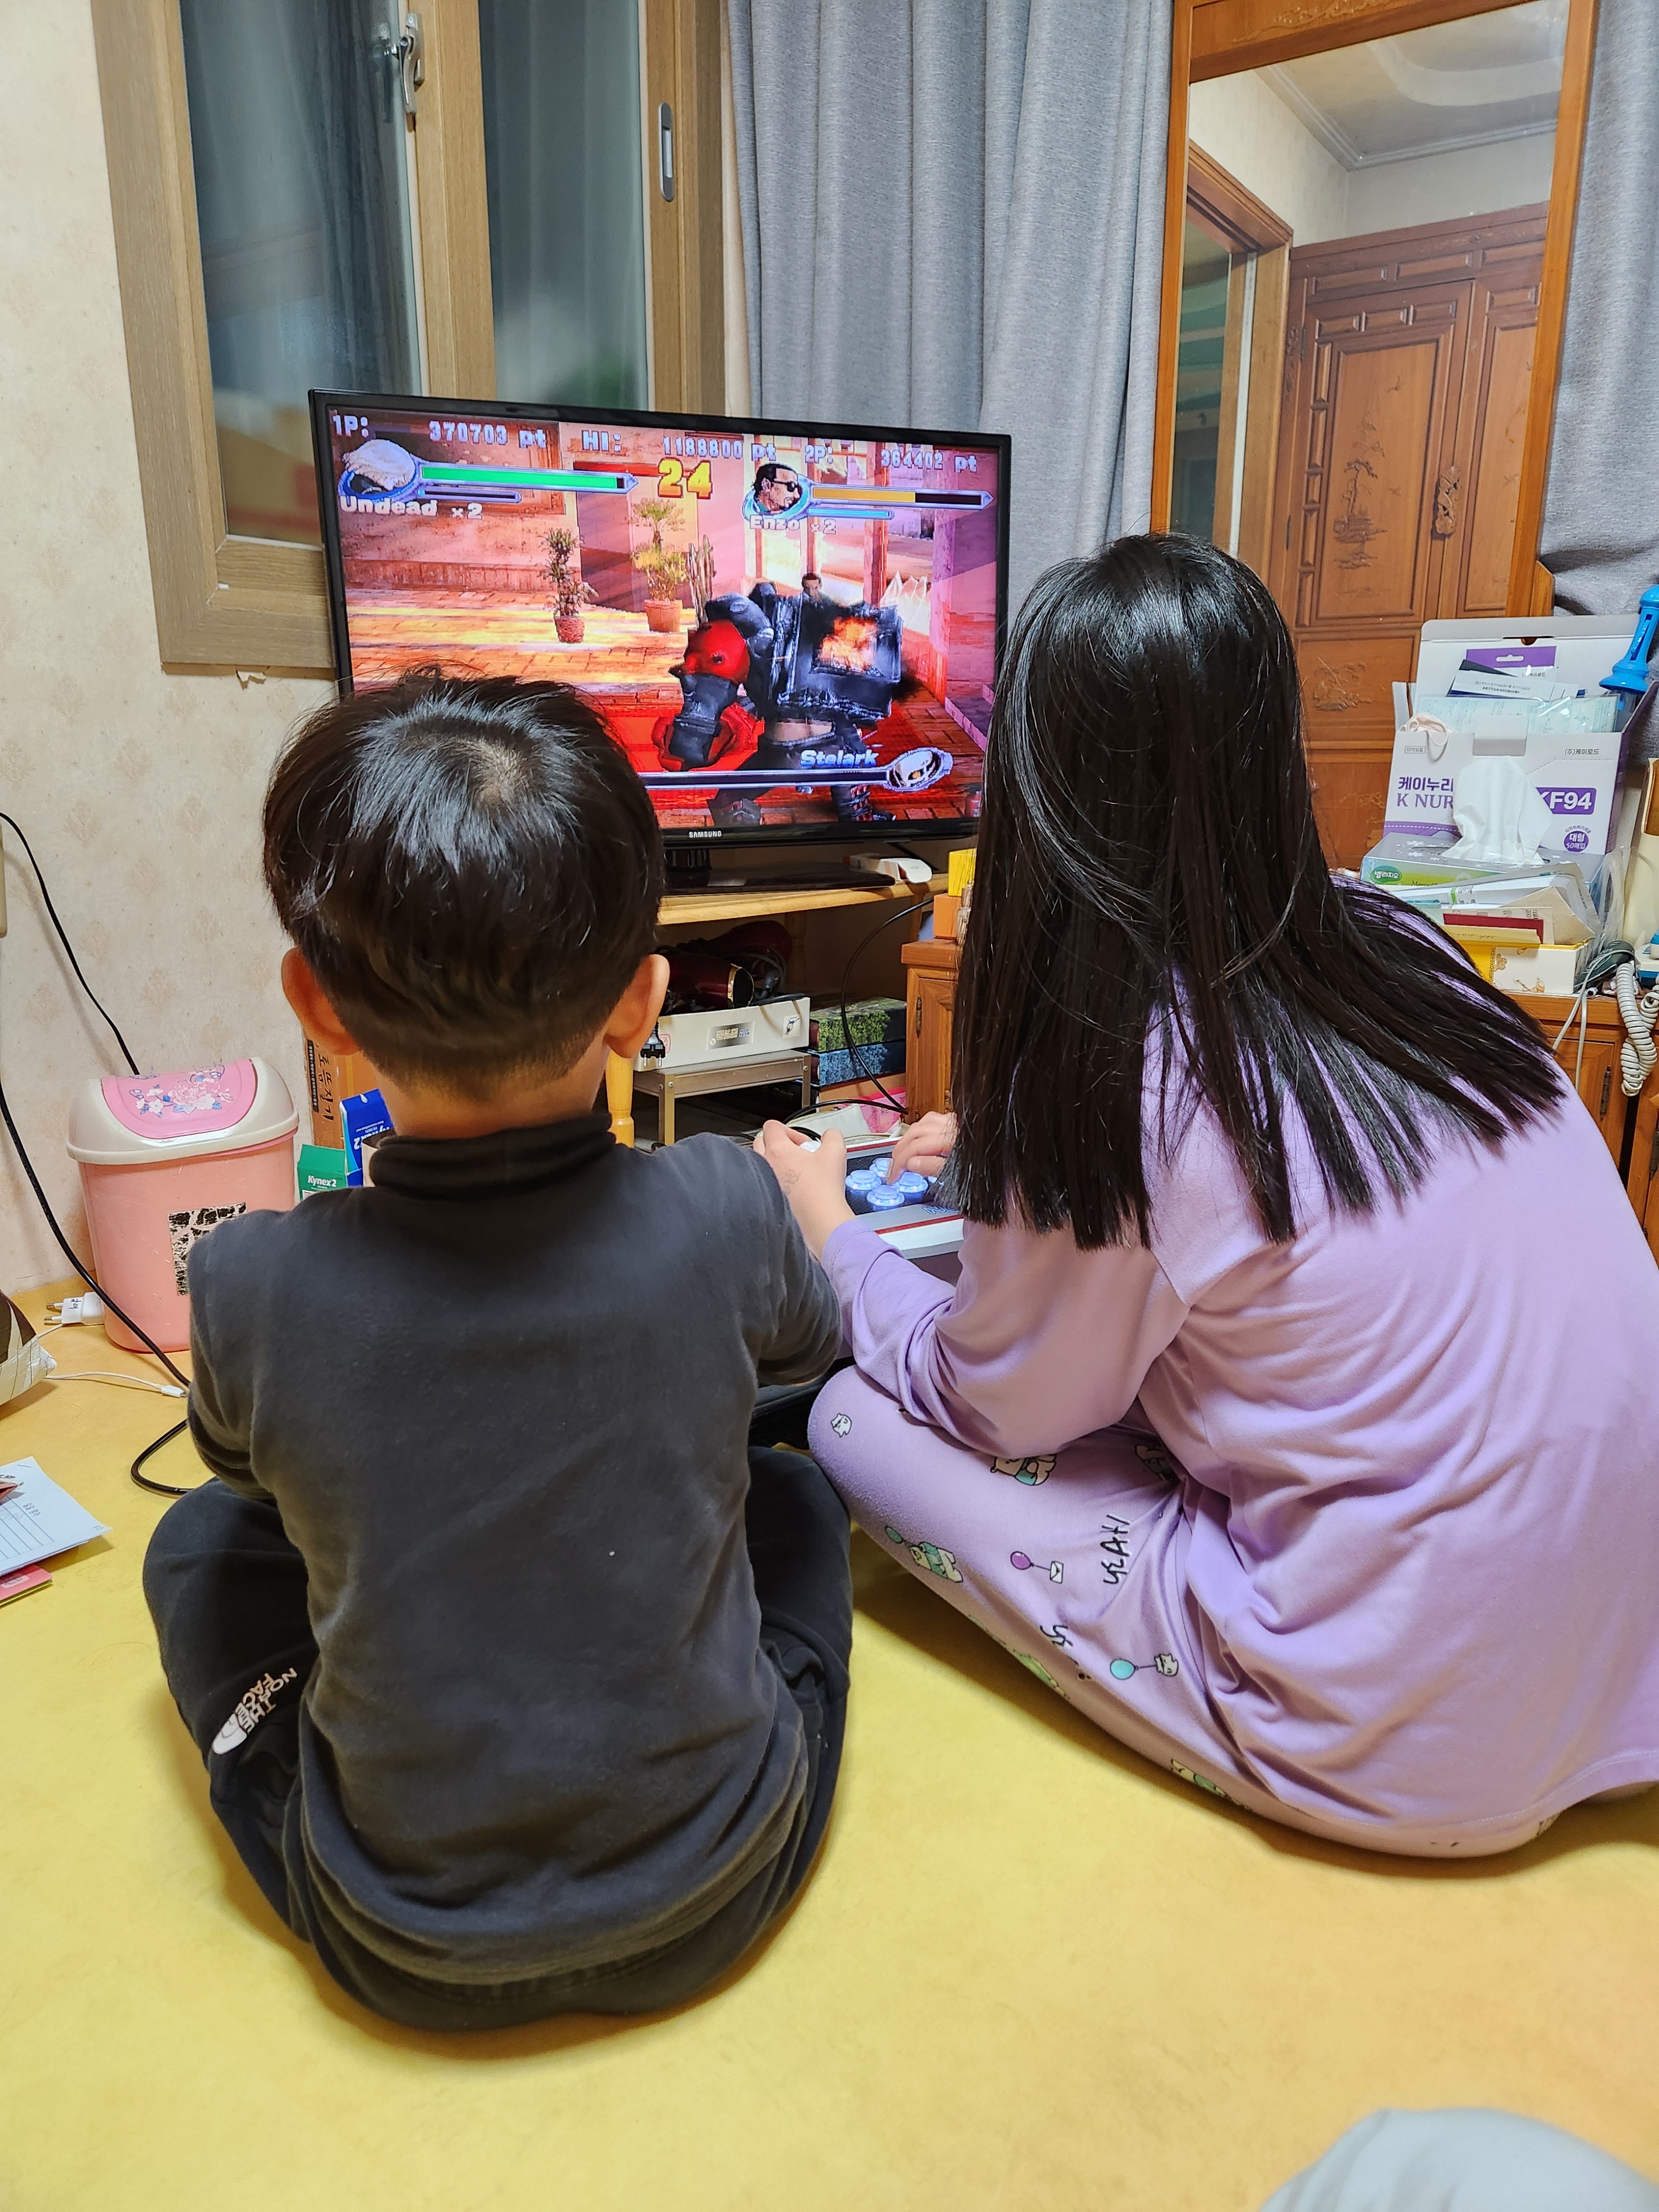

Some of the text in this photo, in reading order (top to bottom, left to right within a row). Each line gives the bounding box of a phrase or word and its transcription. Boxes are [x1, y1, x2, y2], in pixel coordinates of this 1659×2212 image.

[332, 415, 547, 449] 1P: 370703 pt
[663, 436, 743, 459] 1188800
[751, 443, 776, 462] pt
[805, 445, 978, 473] 2P: 364402 pt
[658, 457, 713, 499] 24
[340, 495, 437, 517] Undead
[749, 515, 800, 531] Enzo
[800, 749, 879, 768] Stelark
[1397, 792, 1409, 807] K
[688, 830, 722, 838] SAMSUNG
[1569, 833, 1585, 842] 대형
[315, 1043, 334, 1121] 토뜸질기
